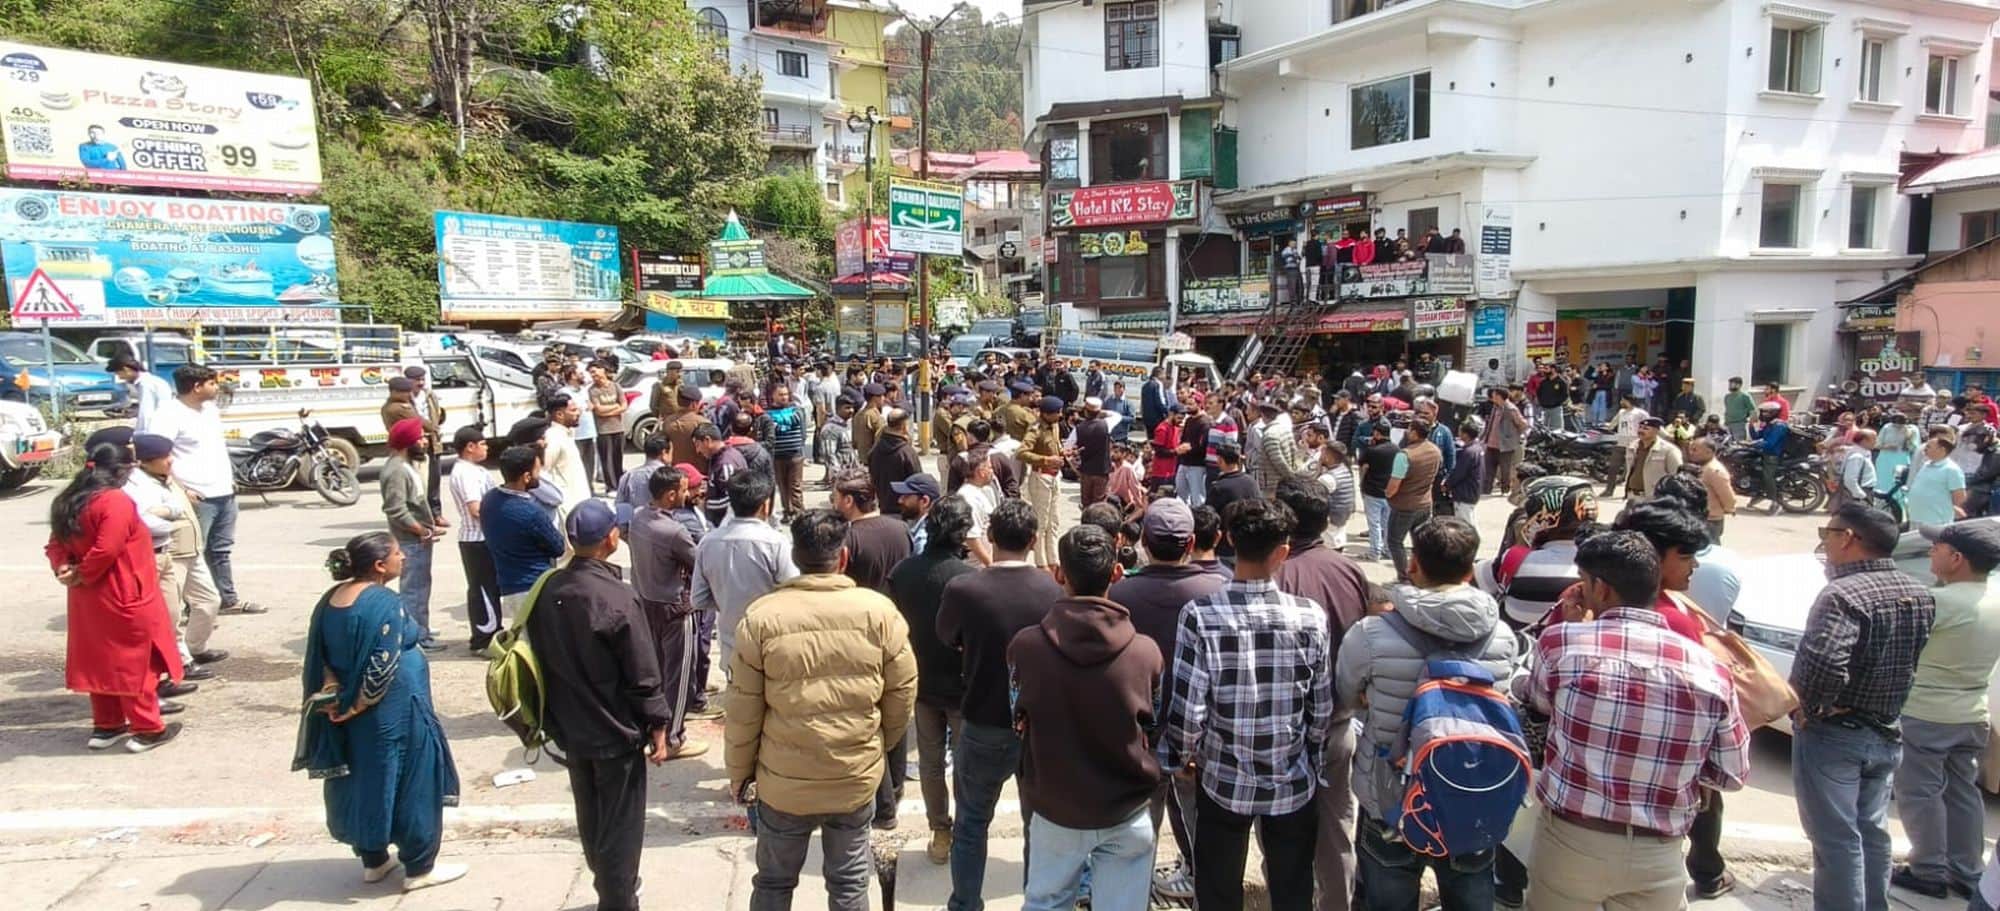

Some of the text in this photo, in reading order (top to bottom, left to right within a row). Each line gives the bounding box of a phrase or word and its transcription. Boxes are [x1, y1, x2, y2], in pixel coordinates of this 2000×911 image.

[82, 89, 244, 118] Pizza Story
[132, 119, 206, 133] OPEN NOW
[131, 138, 204, 154] OPENING
[132, 150, 207, 172] OFFER
[58, 198, 286, 222] ENJOY BOATING
[1074, 200, 1107, 216] Hotel
[1137, 196, 1168, 214] Stay
[131, 242, 187, 252] BOATING
[688, 302, 715, 313] चाय
[1859, 356, 1917, 377] कृष्णा
